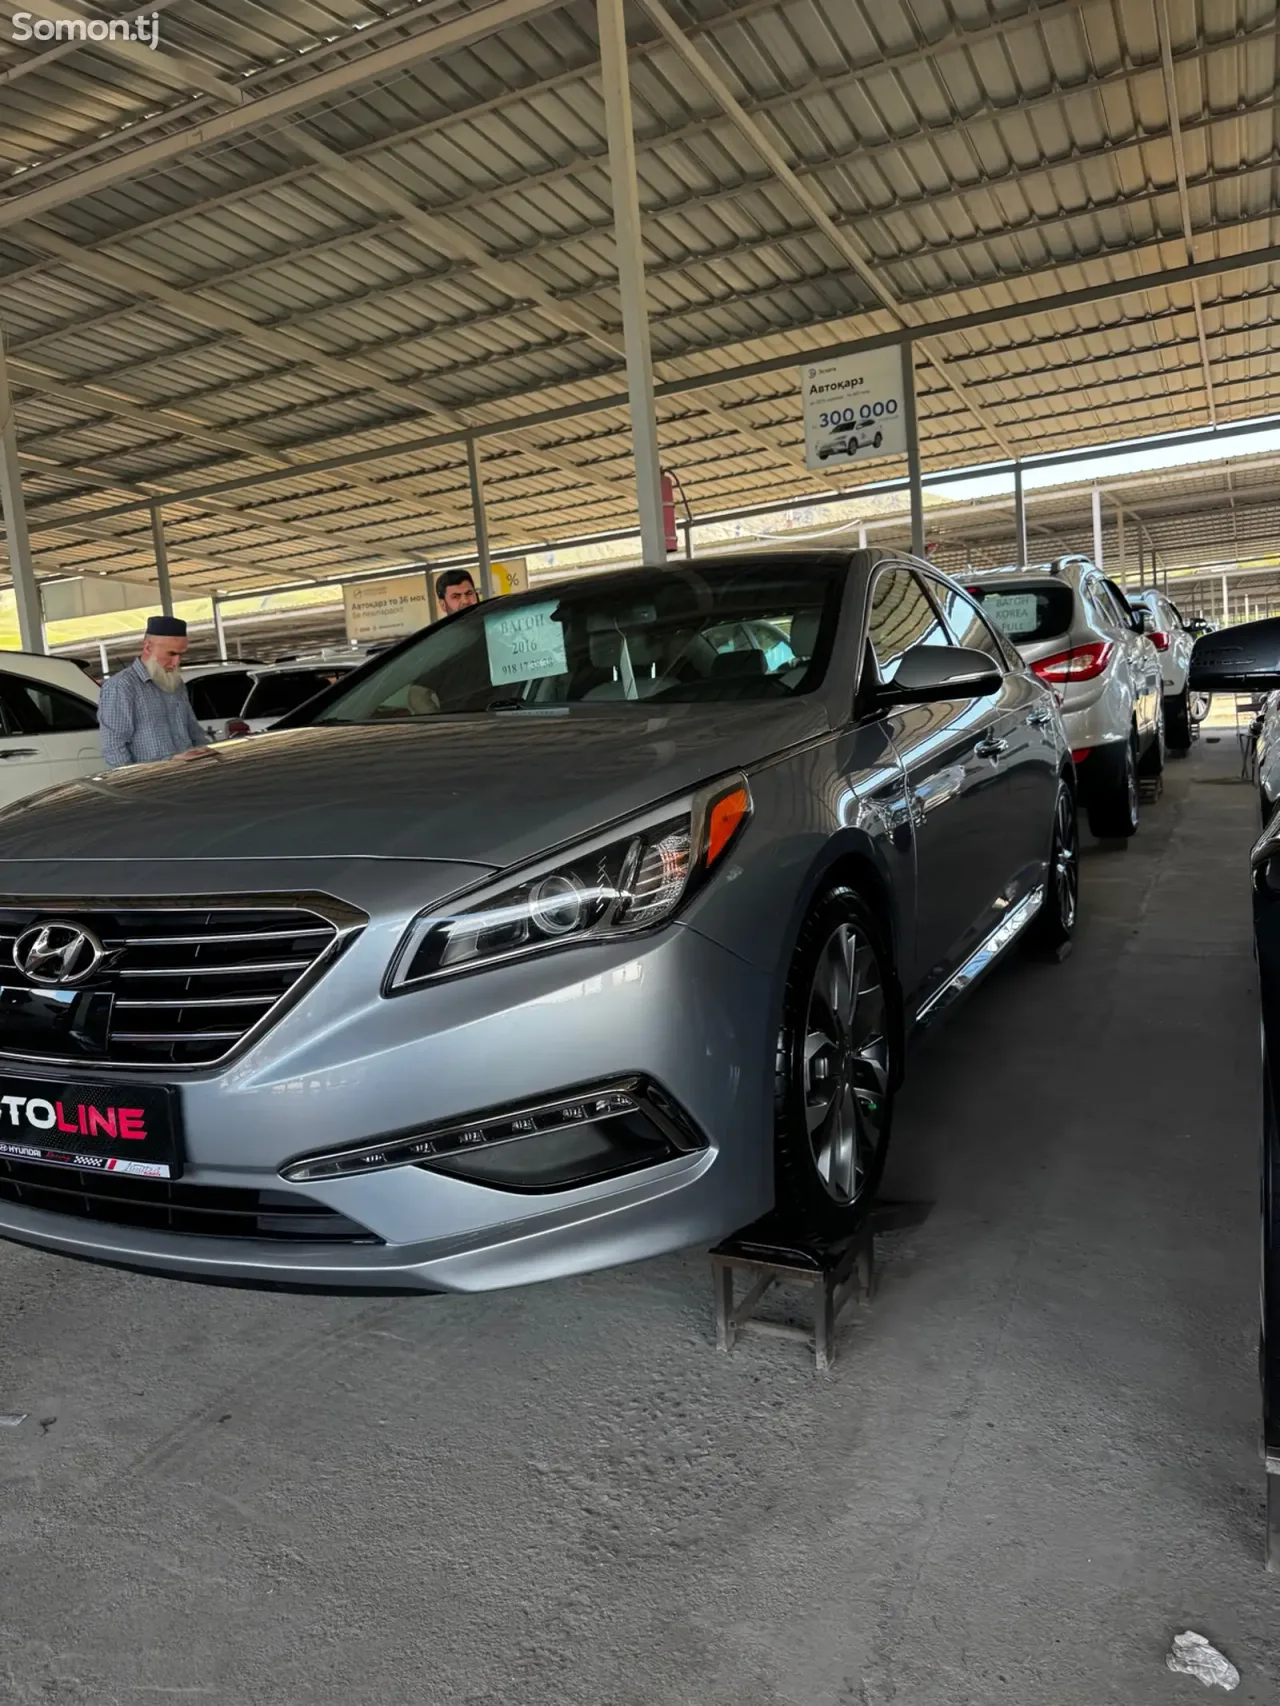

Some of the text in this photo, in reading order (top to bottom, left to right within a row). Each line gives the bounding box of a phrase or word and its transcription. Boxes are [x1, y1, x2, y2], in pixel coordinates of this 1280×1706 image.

[809, 377, 864, 395] Автоқарз
[819, 399, 898, 428] 300 000
[996, 609, 1028, 619] KOREA
[1002, 623, 1024, 632] FULL
[512, 639, 537, 655] 2016
[0, 1095, 148, 1140] TOLINE
[8, 1145, 42, 1158] HYUNDAI
